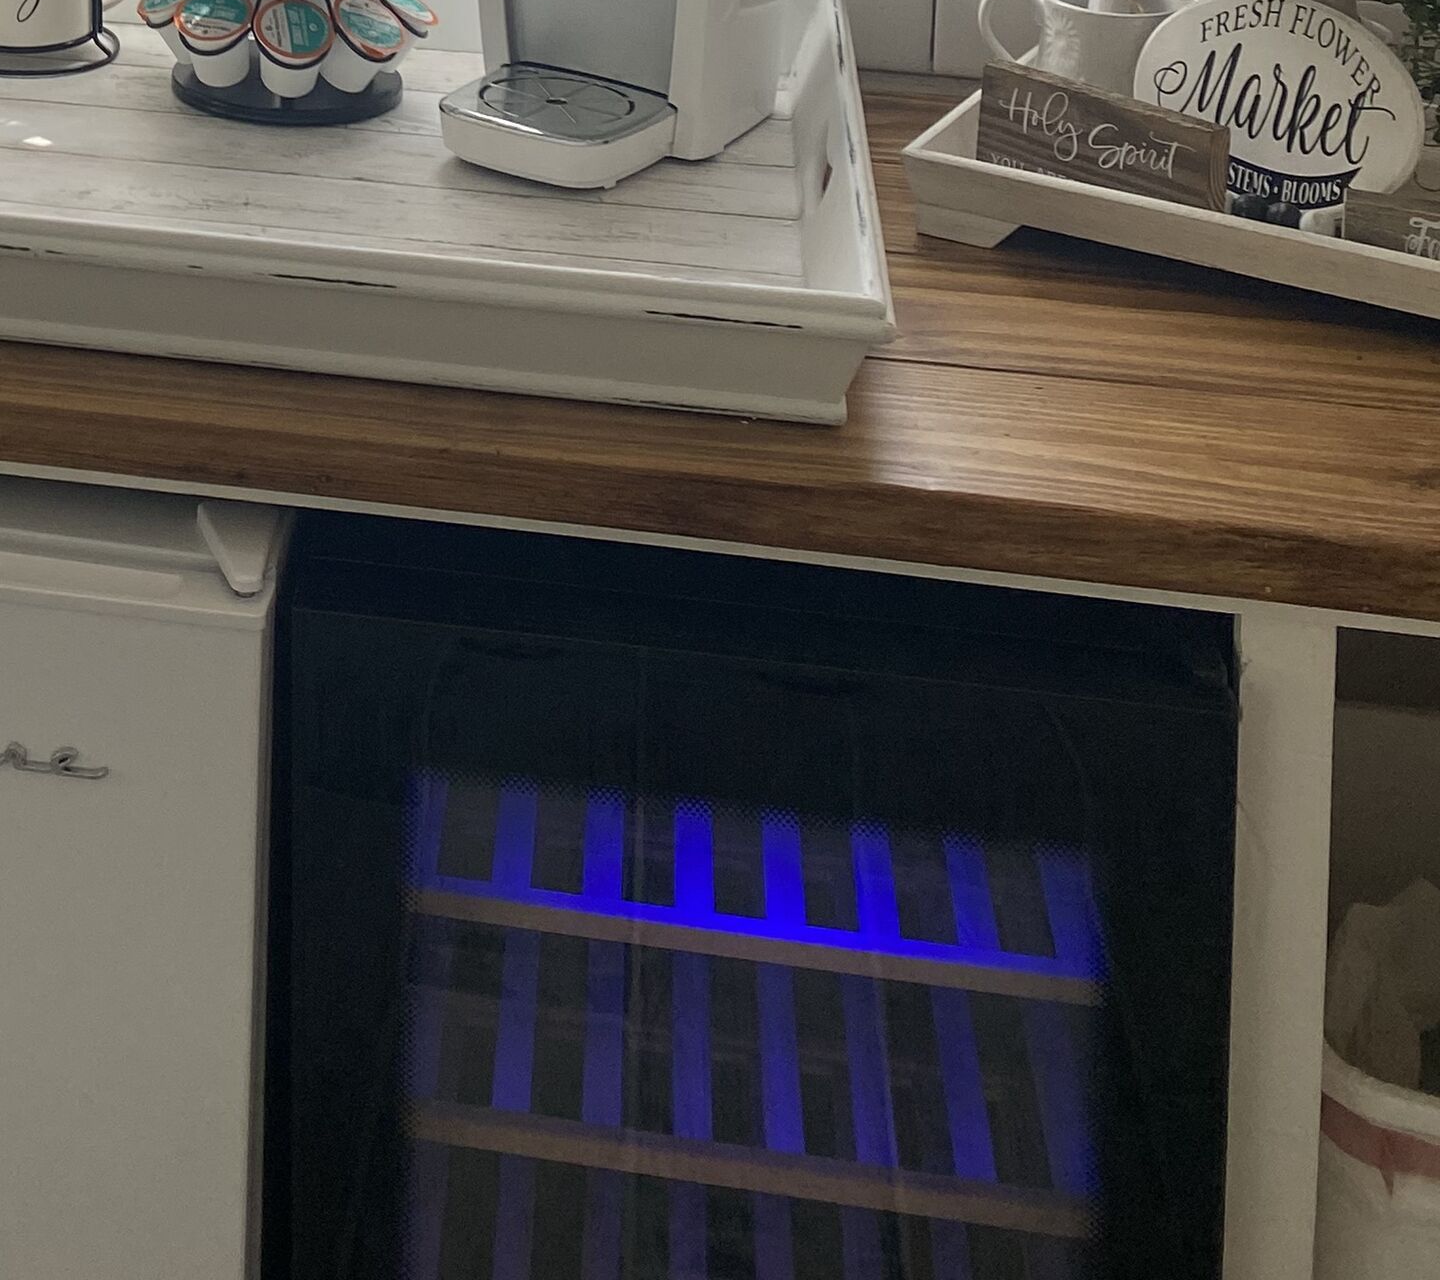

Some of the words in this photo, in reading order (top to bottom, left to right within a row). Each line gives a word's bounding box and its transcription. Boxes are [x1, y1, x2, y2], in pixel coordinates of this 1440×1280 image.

[1199, 0, 1286, 44] FRESH
[1288, 4, 1383, 105] FLOWER
[998, 88, 1084, 162] Holy
[1087, 124, 1198, 179] Spirit
[1154, 43, 1397, 165] Market
[1227, 162, 1272, 200] STEMS
[1281, 178, 1343, 205] BLOOMS
